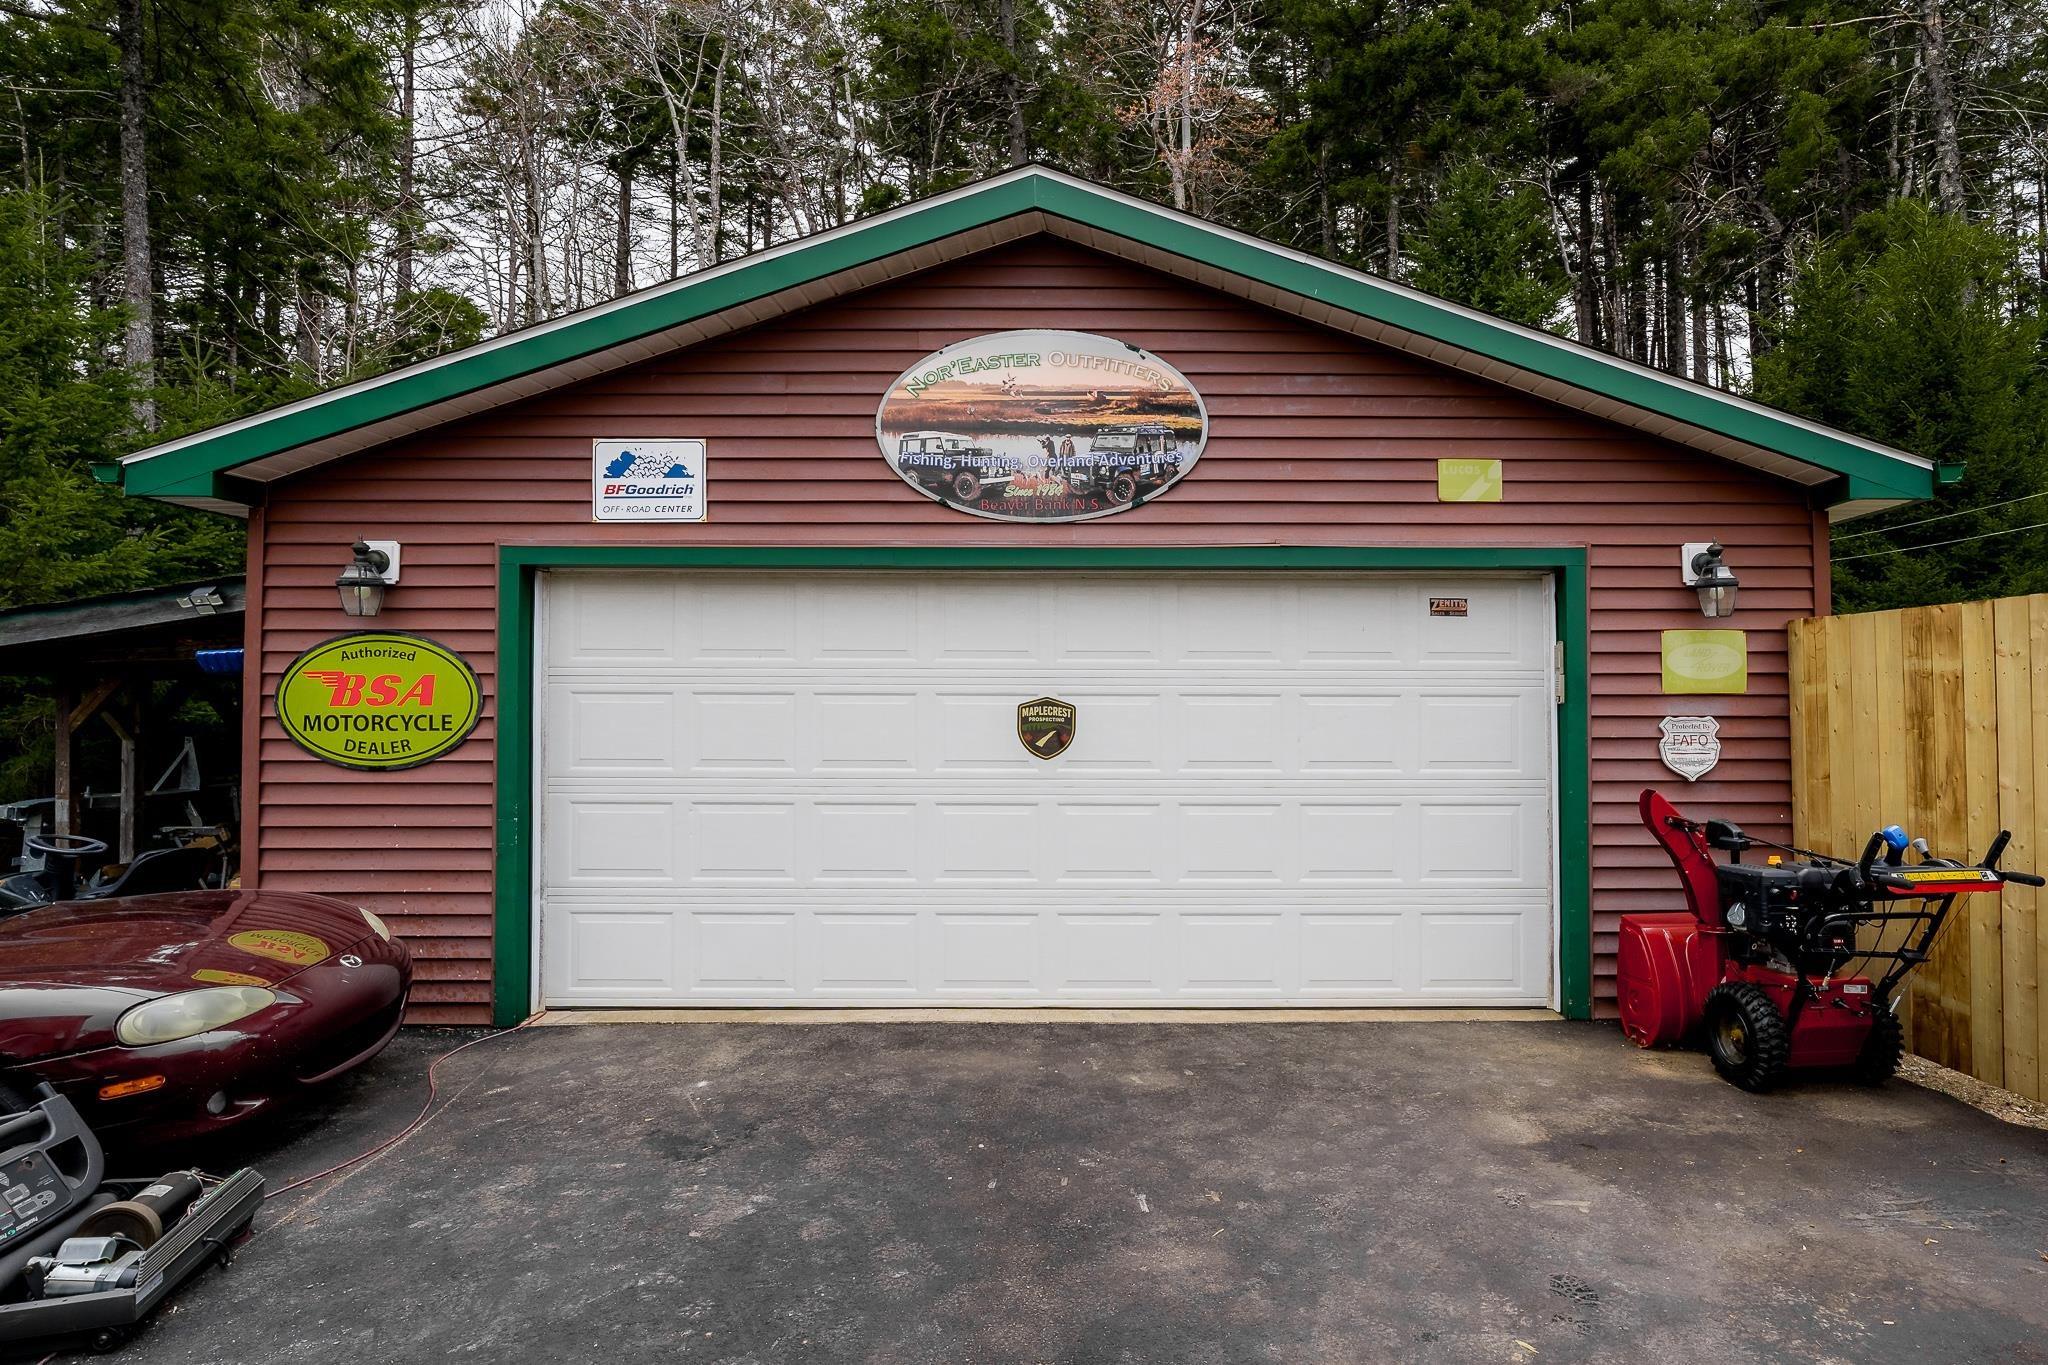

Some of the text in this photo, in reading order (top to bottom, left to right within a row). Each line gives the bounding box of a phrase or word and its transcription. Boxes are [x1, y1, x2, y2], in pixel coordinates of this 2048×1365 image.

[900, 451, 1183, 470] Fishing, Hunting, Overland Adventures
[1442, 463, 1481, 476] Lucas
[604, 484, 694, 495] BFGoodrich
[654, 505, 693, 513] CENTER
[980, 498, 1029, 511] Beaver
[1035, 498, 1070, 511] Bank
[341, 646, 416, 662] Authorized
[325, 672, 436, 707] BSA
[1022, 706, 1072, 718] MAPLECREST
[303, 714, 453, 732] MOTORCYCLE
[343, 738, 412, 755] DEALER
[1672, 734, 1708, 746] FAFO
